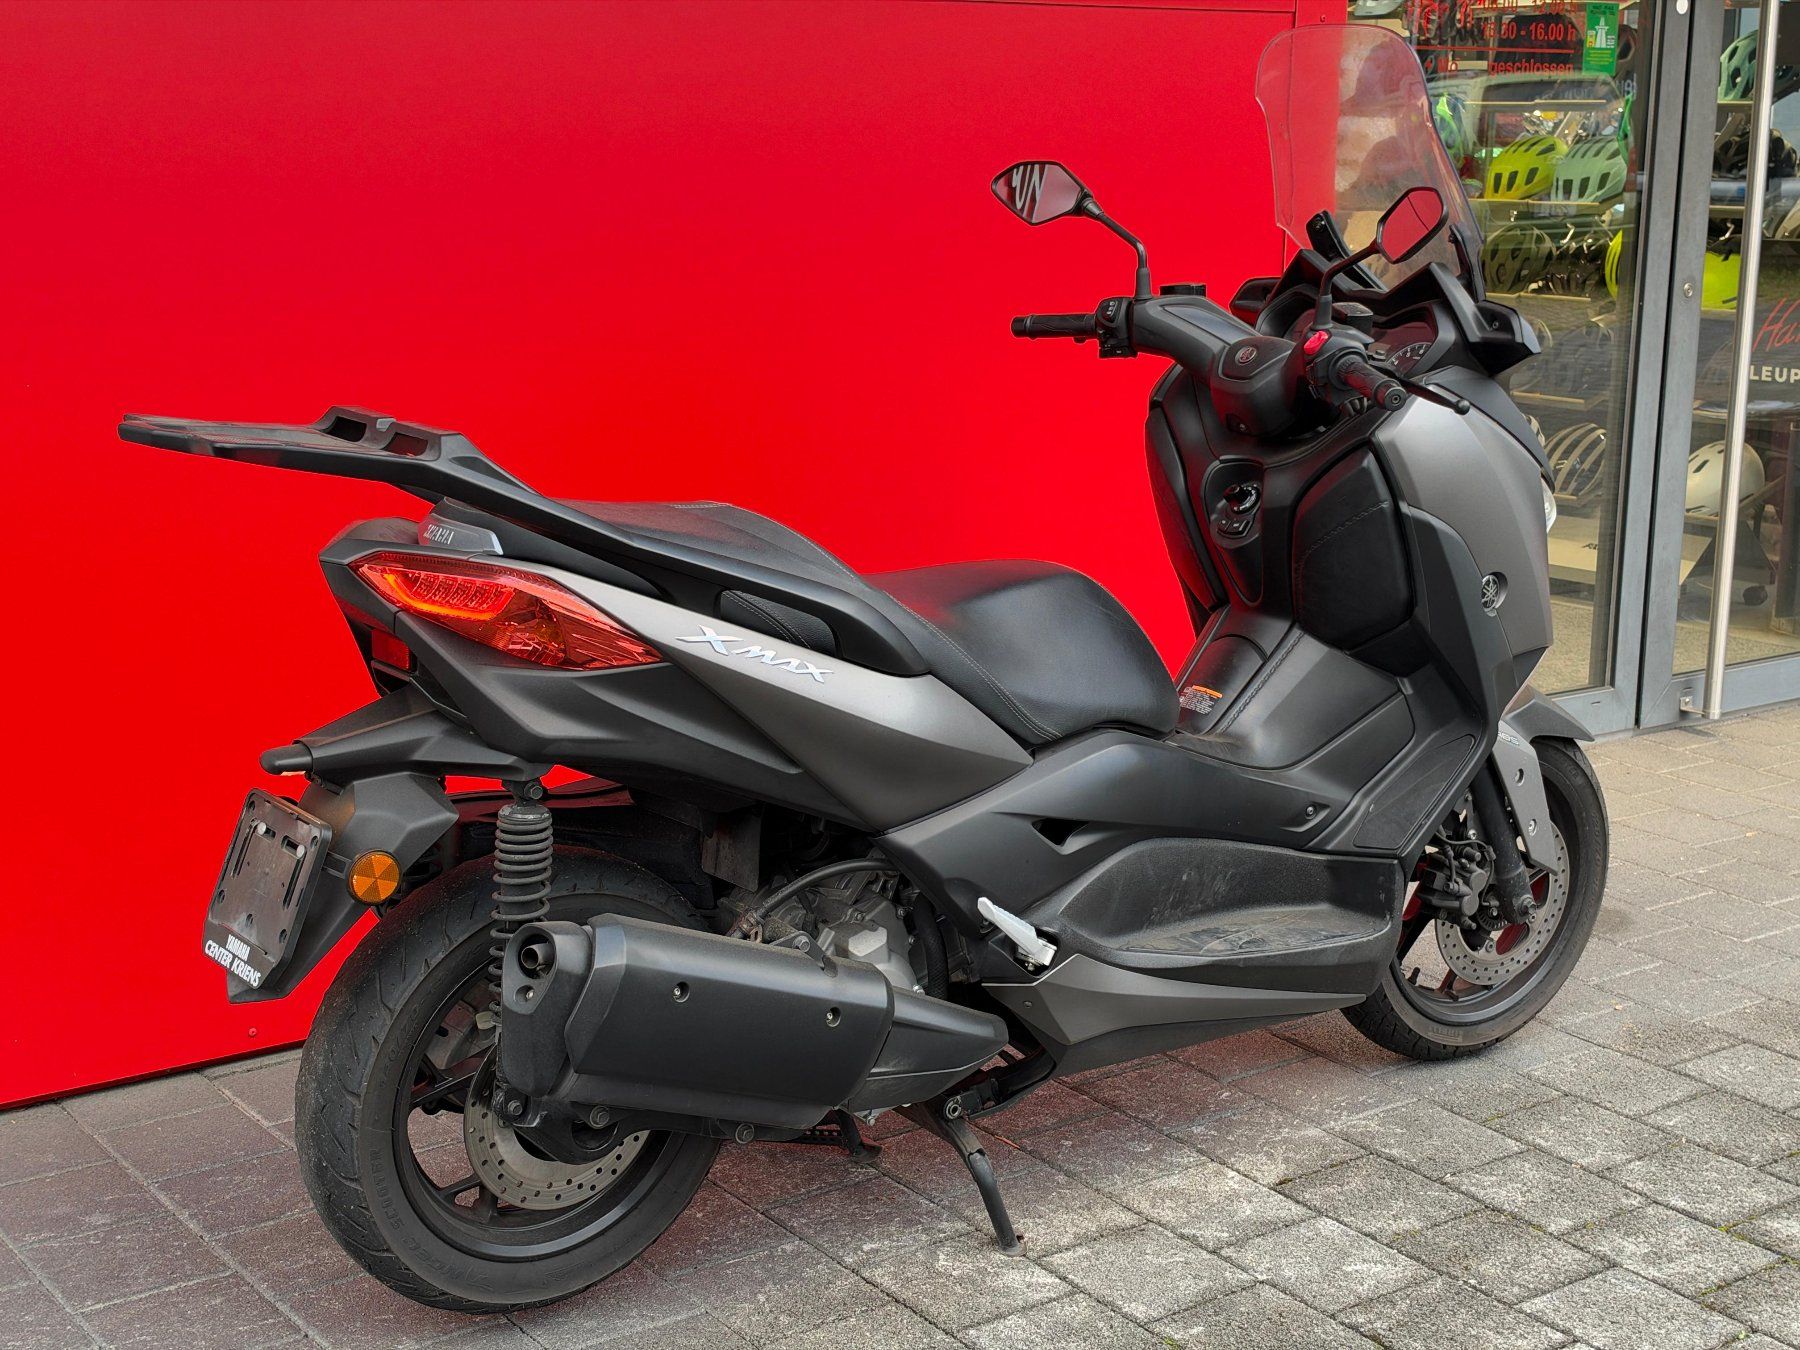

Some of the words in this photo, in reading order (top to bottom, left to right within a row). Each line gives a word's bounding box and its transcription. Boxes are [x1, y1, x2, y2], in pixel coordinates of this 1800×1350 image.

[1530, 22, 1565, 41] 16.00
[1567, 23, 1577, 41] h
[1488, 59, 1574, 76] geschlossen
[226, 933, 251, 962] YAMAHA
[204, 940, 233, 969] CENTER
[231, 957, 261, 987] KRIENS
